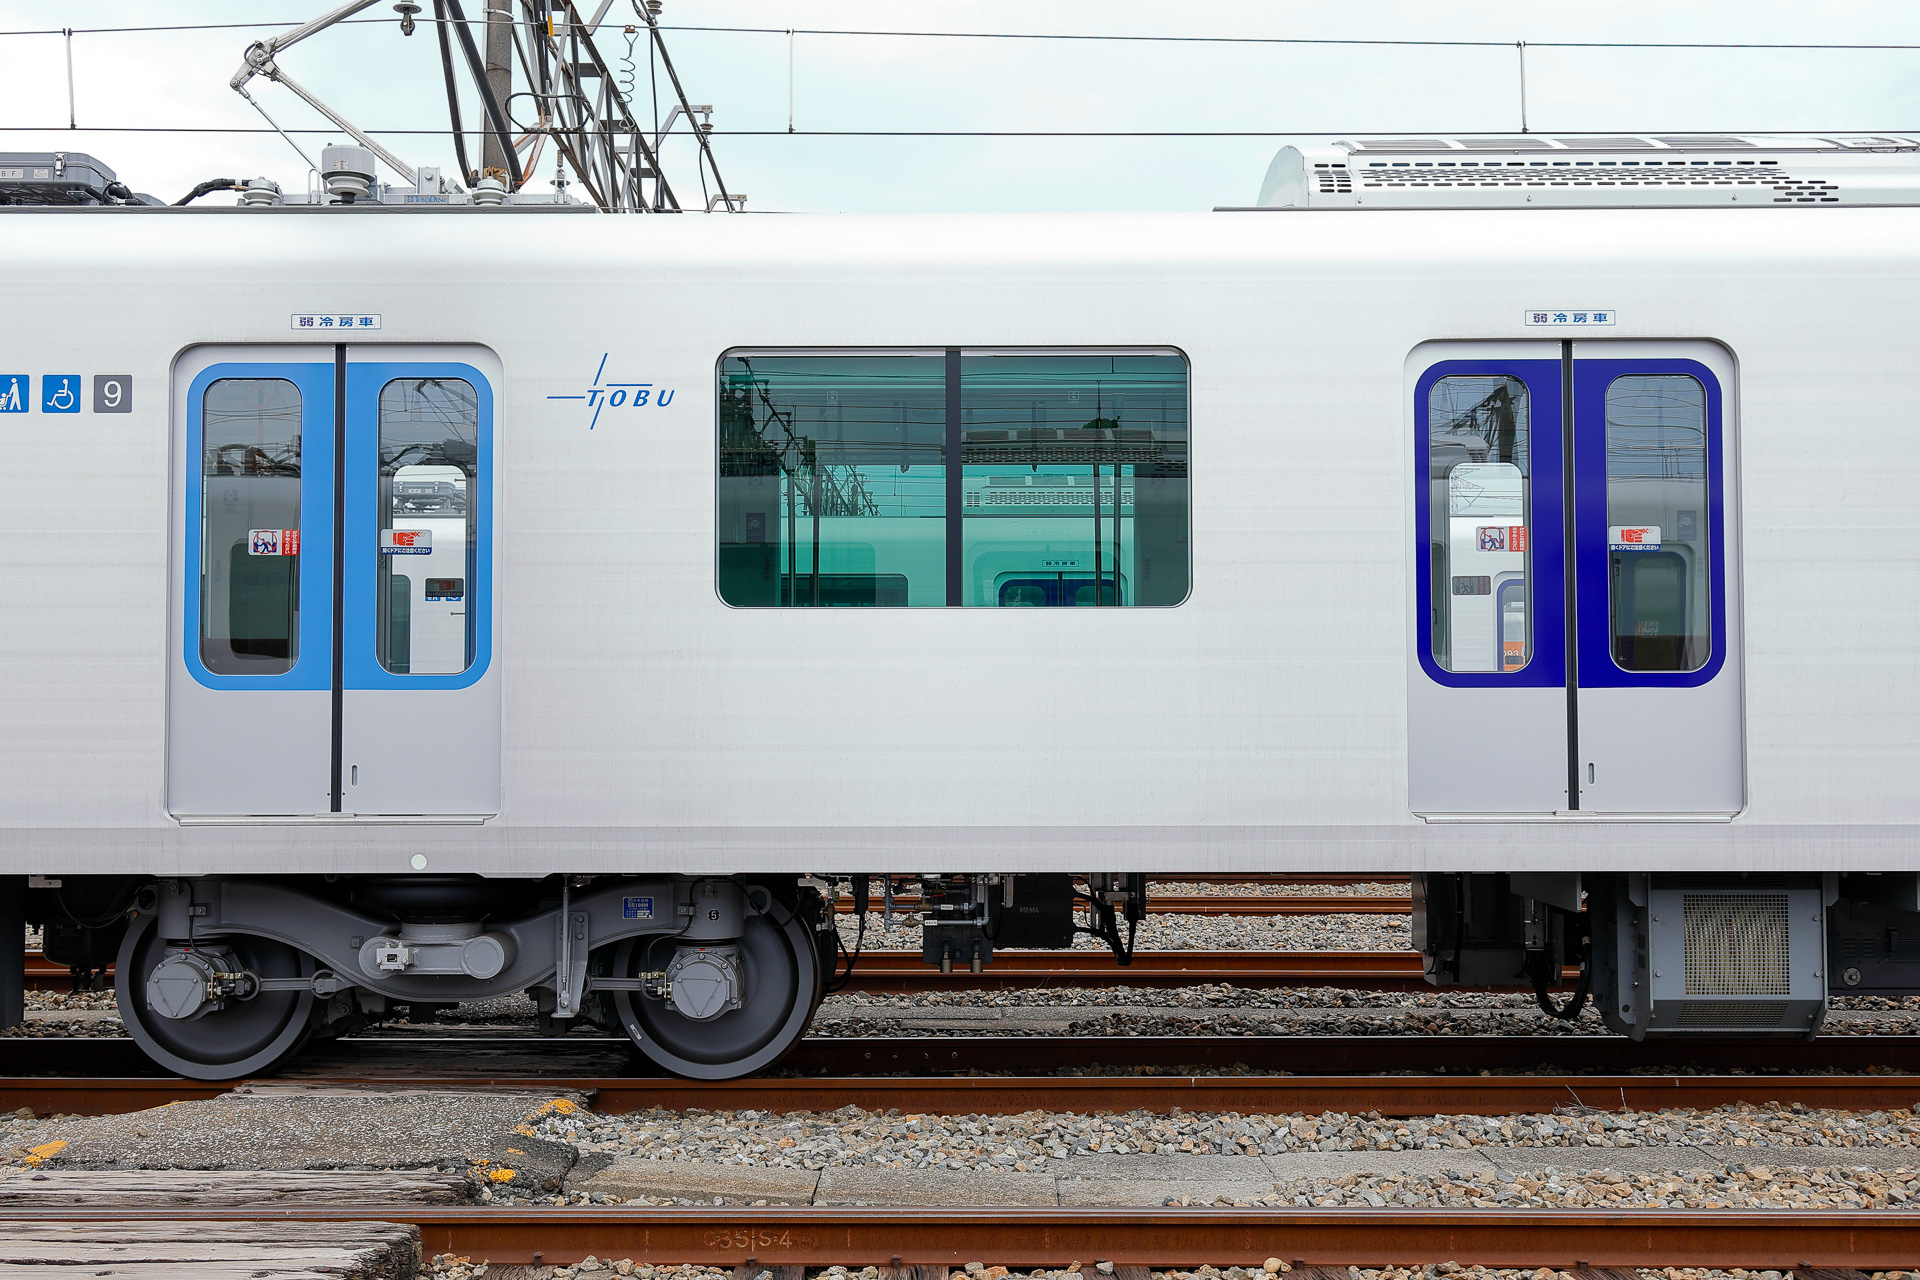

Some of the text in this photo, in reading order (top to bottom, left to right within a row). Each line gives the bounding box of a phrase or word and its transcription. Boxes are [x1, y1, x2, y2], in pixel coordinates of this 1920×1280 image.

[299, 316, 374, 327] 弱冷房車
[1532, 313, 1608, 323] 弱冷房車
[104, 380, 122, 407] 9
[587, 389, 675, 407] TOBU
